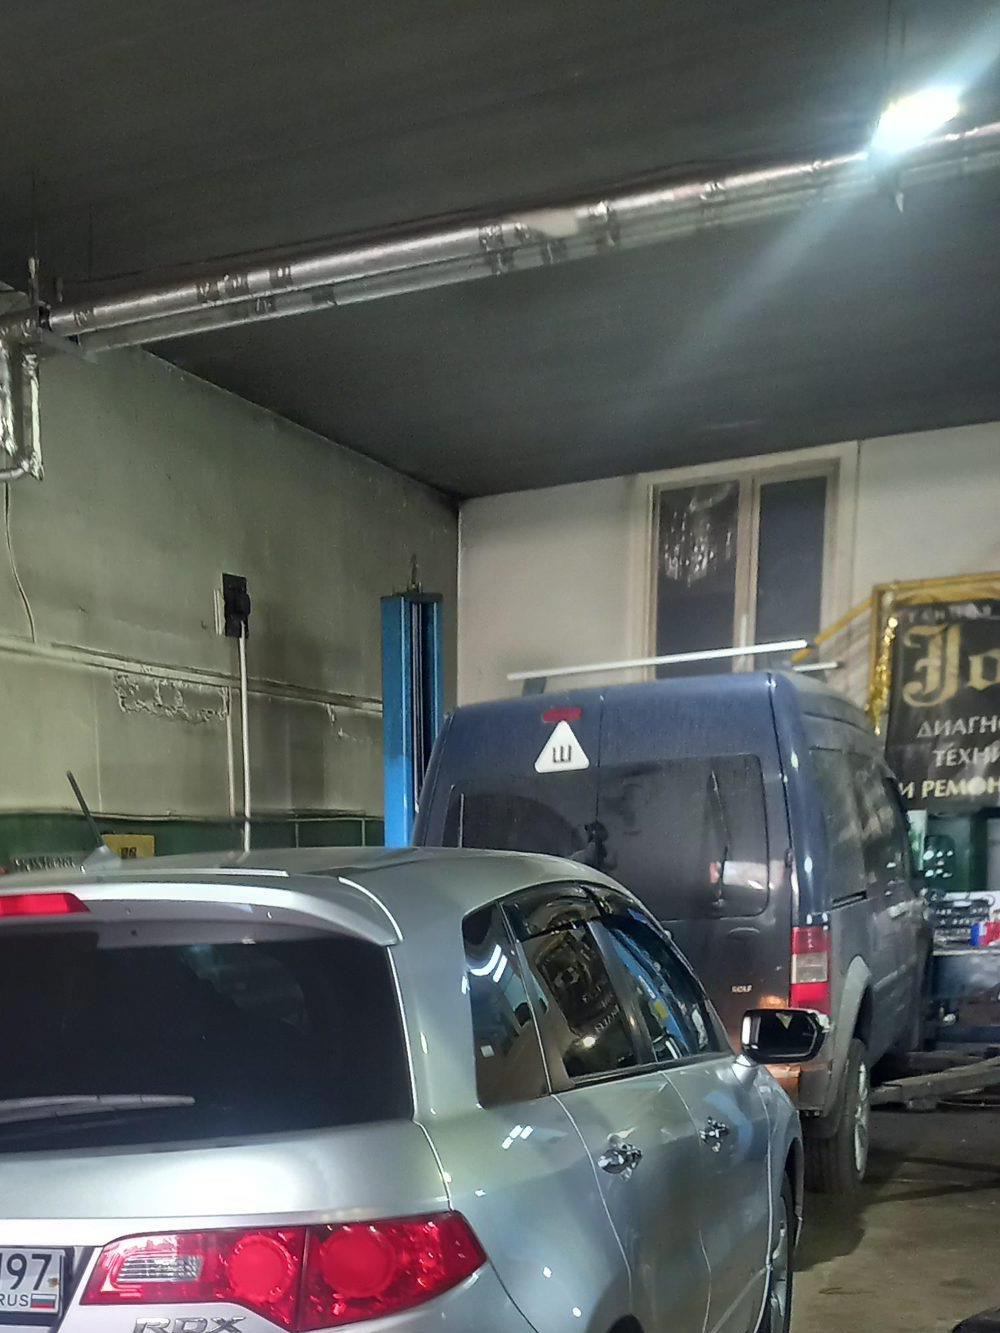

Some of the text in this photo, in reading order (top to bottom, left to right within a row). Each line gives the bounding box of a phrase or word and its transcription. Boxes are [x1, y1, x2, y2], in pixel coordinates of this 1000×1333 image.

[916, 715, 1000, 738] ДИАГН
[552, 745, 572, 763] Ш
[898, 781, 914, 799] И
